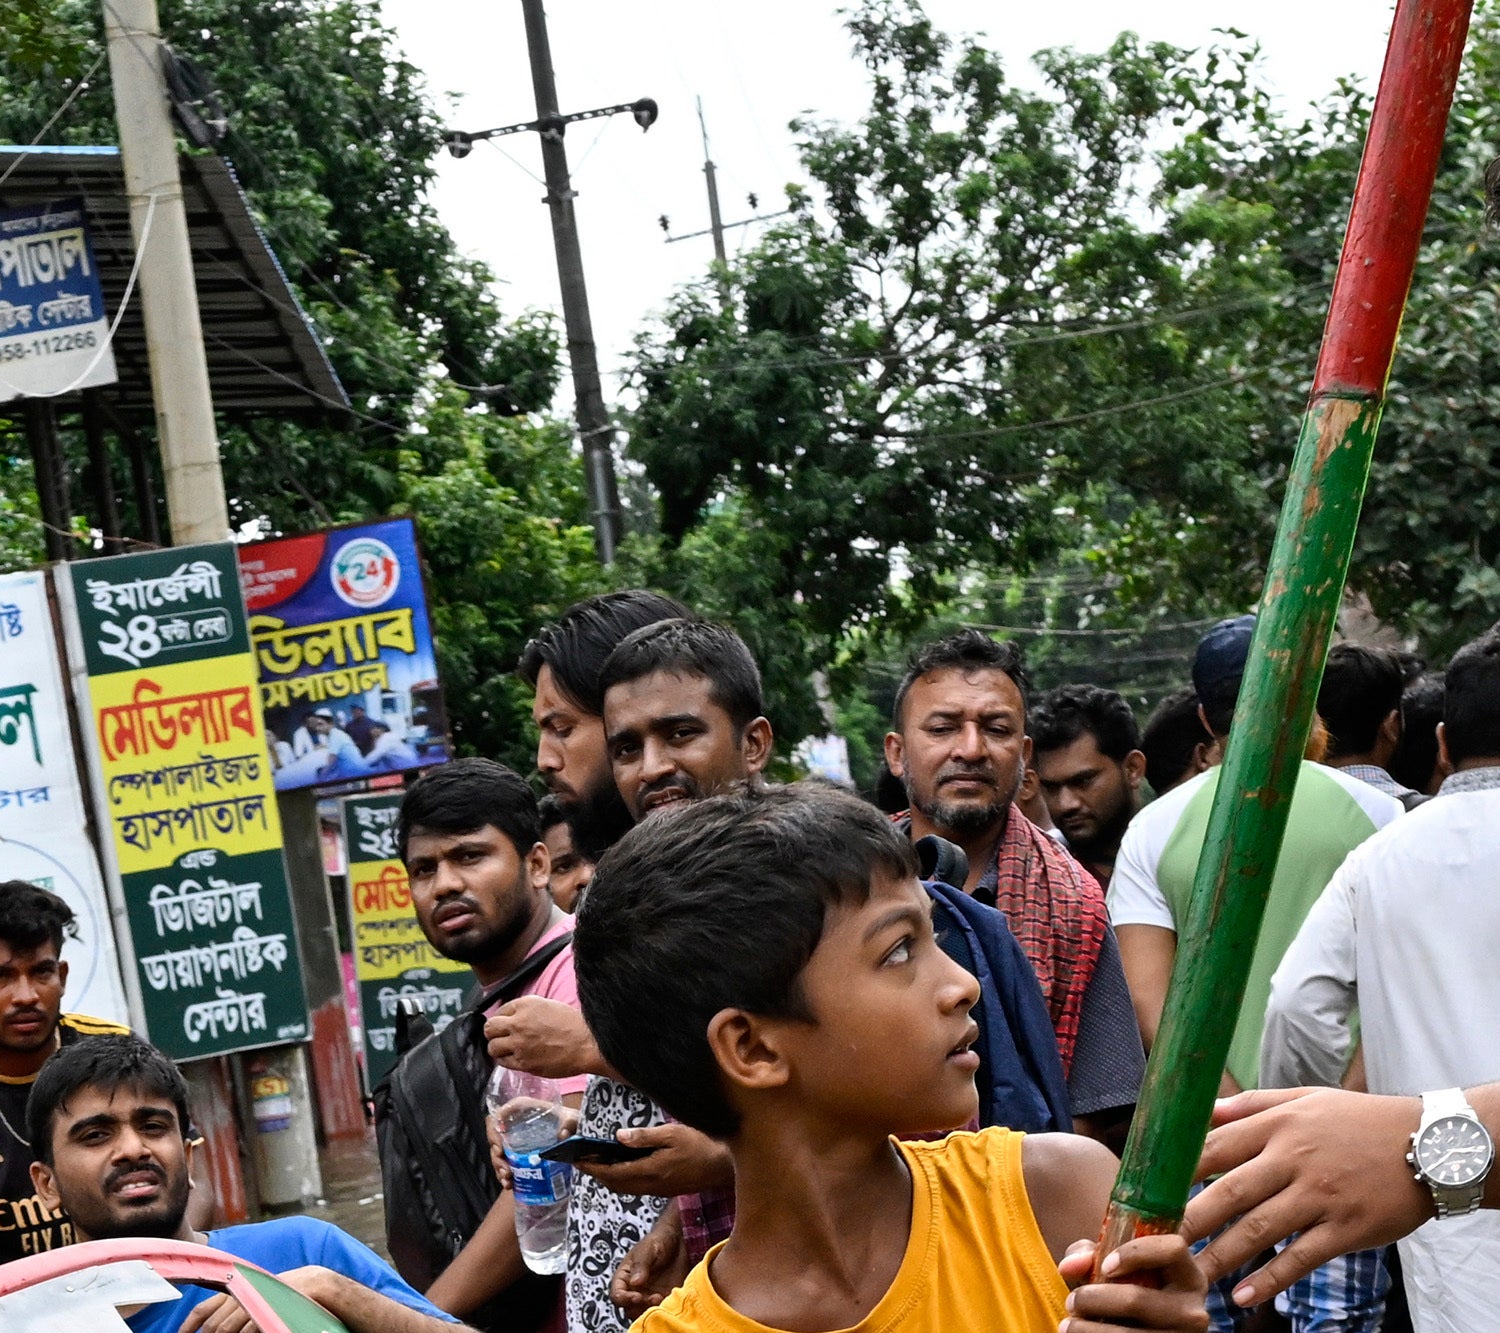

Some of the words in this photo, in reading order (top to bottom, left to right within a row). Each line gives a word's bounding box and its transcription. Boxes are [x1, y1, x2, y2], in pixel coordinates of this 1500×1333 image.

[97, 614, 163, 668] ২৪
[250, 607, 416, 680] ডিল্যাব
[259, 662, 390, 709] সপাতাল
[98, 678, 256, 762] মেডিল্যাব
[109, 752, 261, 805] স্পেশালাইজড
[115, 794, 269, 851] হাসপাতাল
[148, 876, 264, 937] ডিজিটাল
[353, 865, 412, 915] মেডি
[183, 986, 267, 1043] সেন্টার
